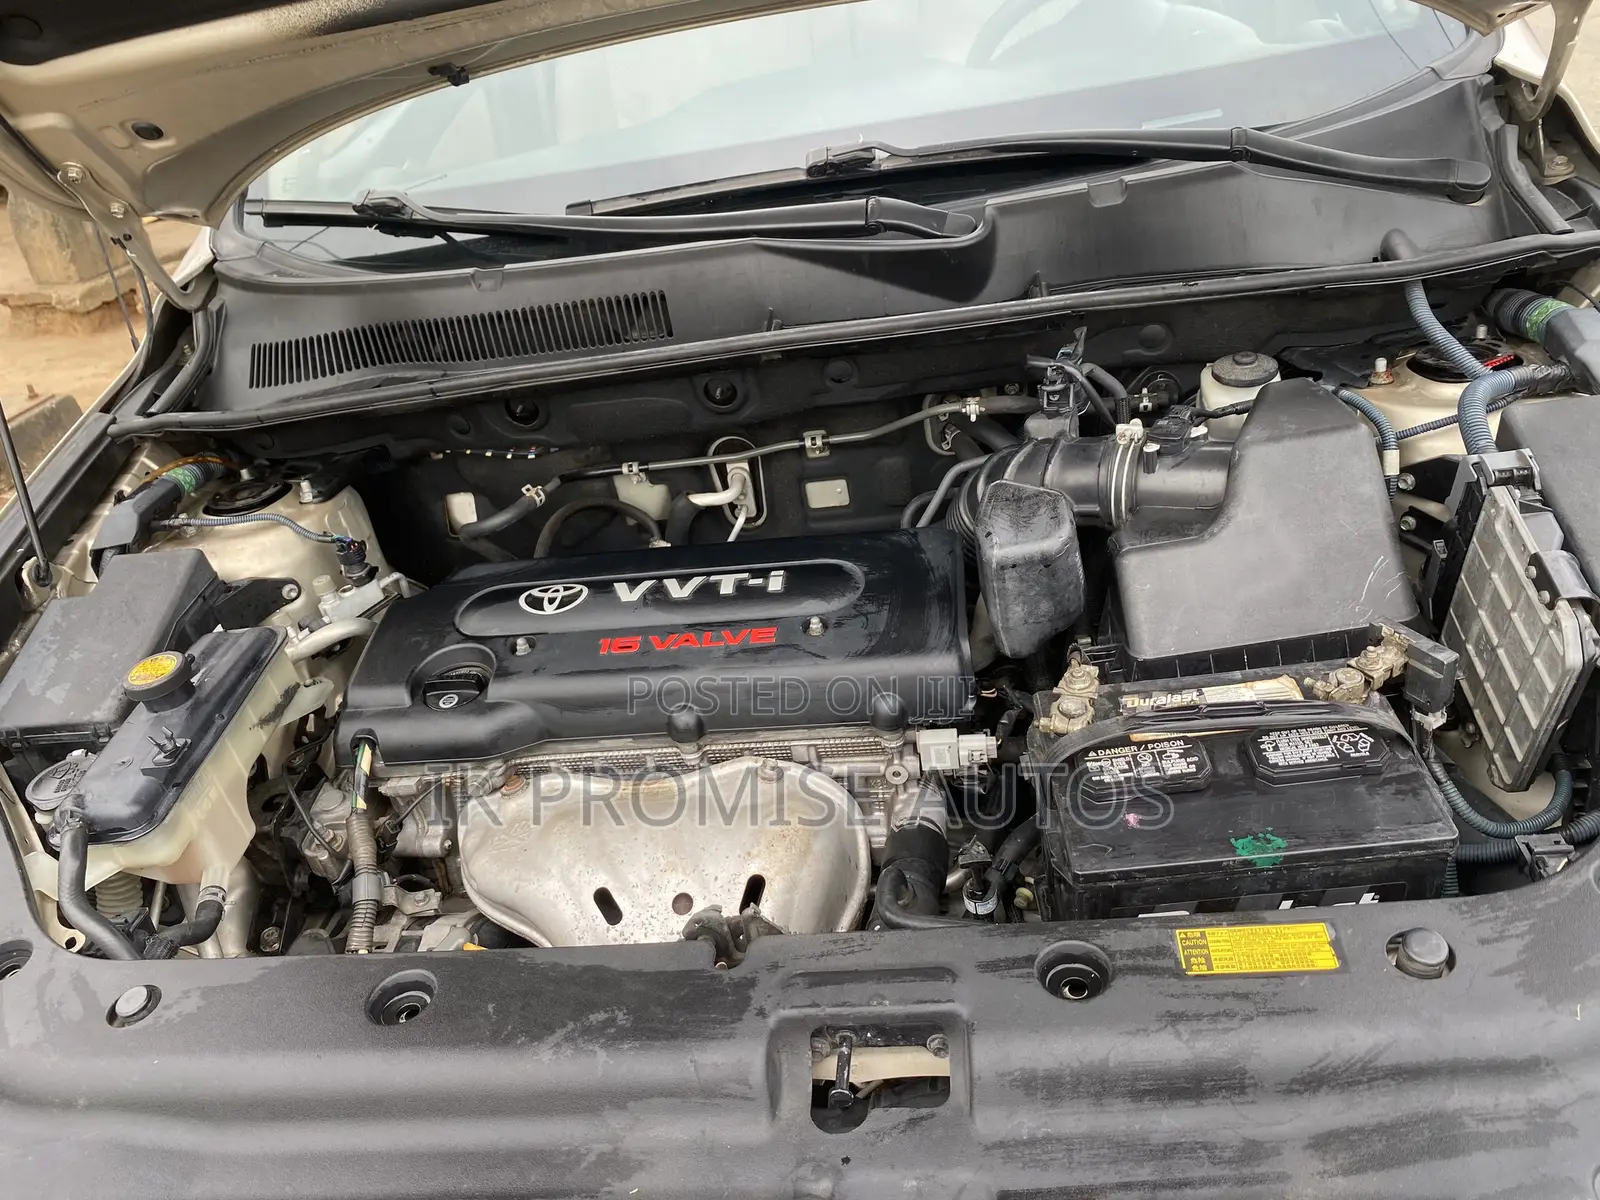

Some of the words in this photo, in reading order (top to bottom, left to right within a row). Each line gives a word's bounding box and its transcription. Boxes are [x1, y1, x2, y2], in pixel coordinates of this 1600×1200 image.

[613, 569, 786, 602] VVT-i
[599, 635, 643, 656] 16
[648, 626, 778, 651] VALVE
[1127, 690, 1201, 709] Duralast
[1097, 745, 1138, 756] DANGER
[1147, 740, 1185, 750] POISON
[1181, 938, 1207, 946] CAUTION
[1184, 948, 1209, 956] ATTENTION
